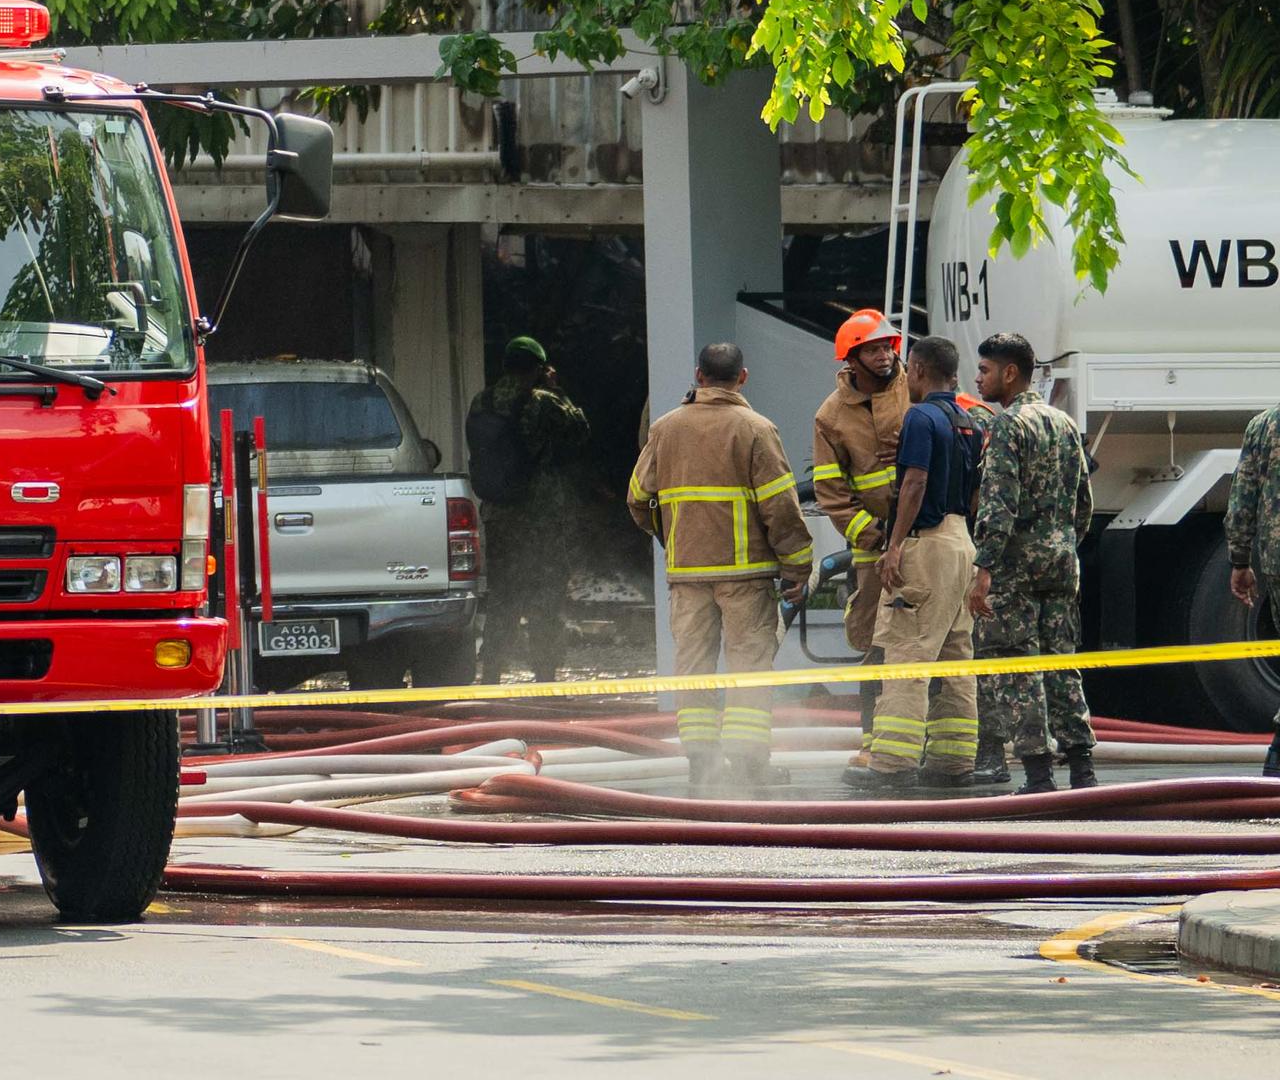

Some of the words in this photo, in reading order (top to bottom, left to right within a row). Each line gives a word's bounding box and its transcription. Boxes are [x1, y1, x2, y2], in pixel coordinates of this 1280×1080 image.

[1168, 239, 1280, 289] WB
[941, 259, 989, 322] WB-1
[270, 635, 331, 650] G3303
